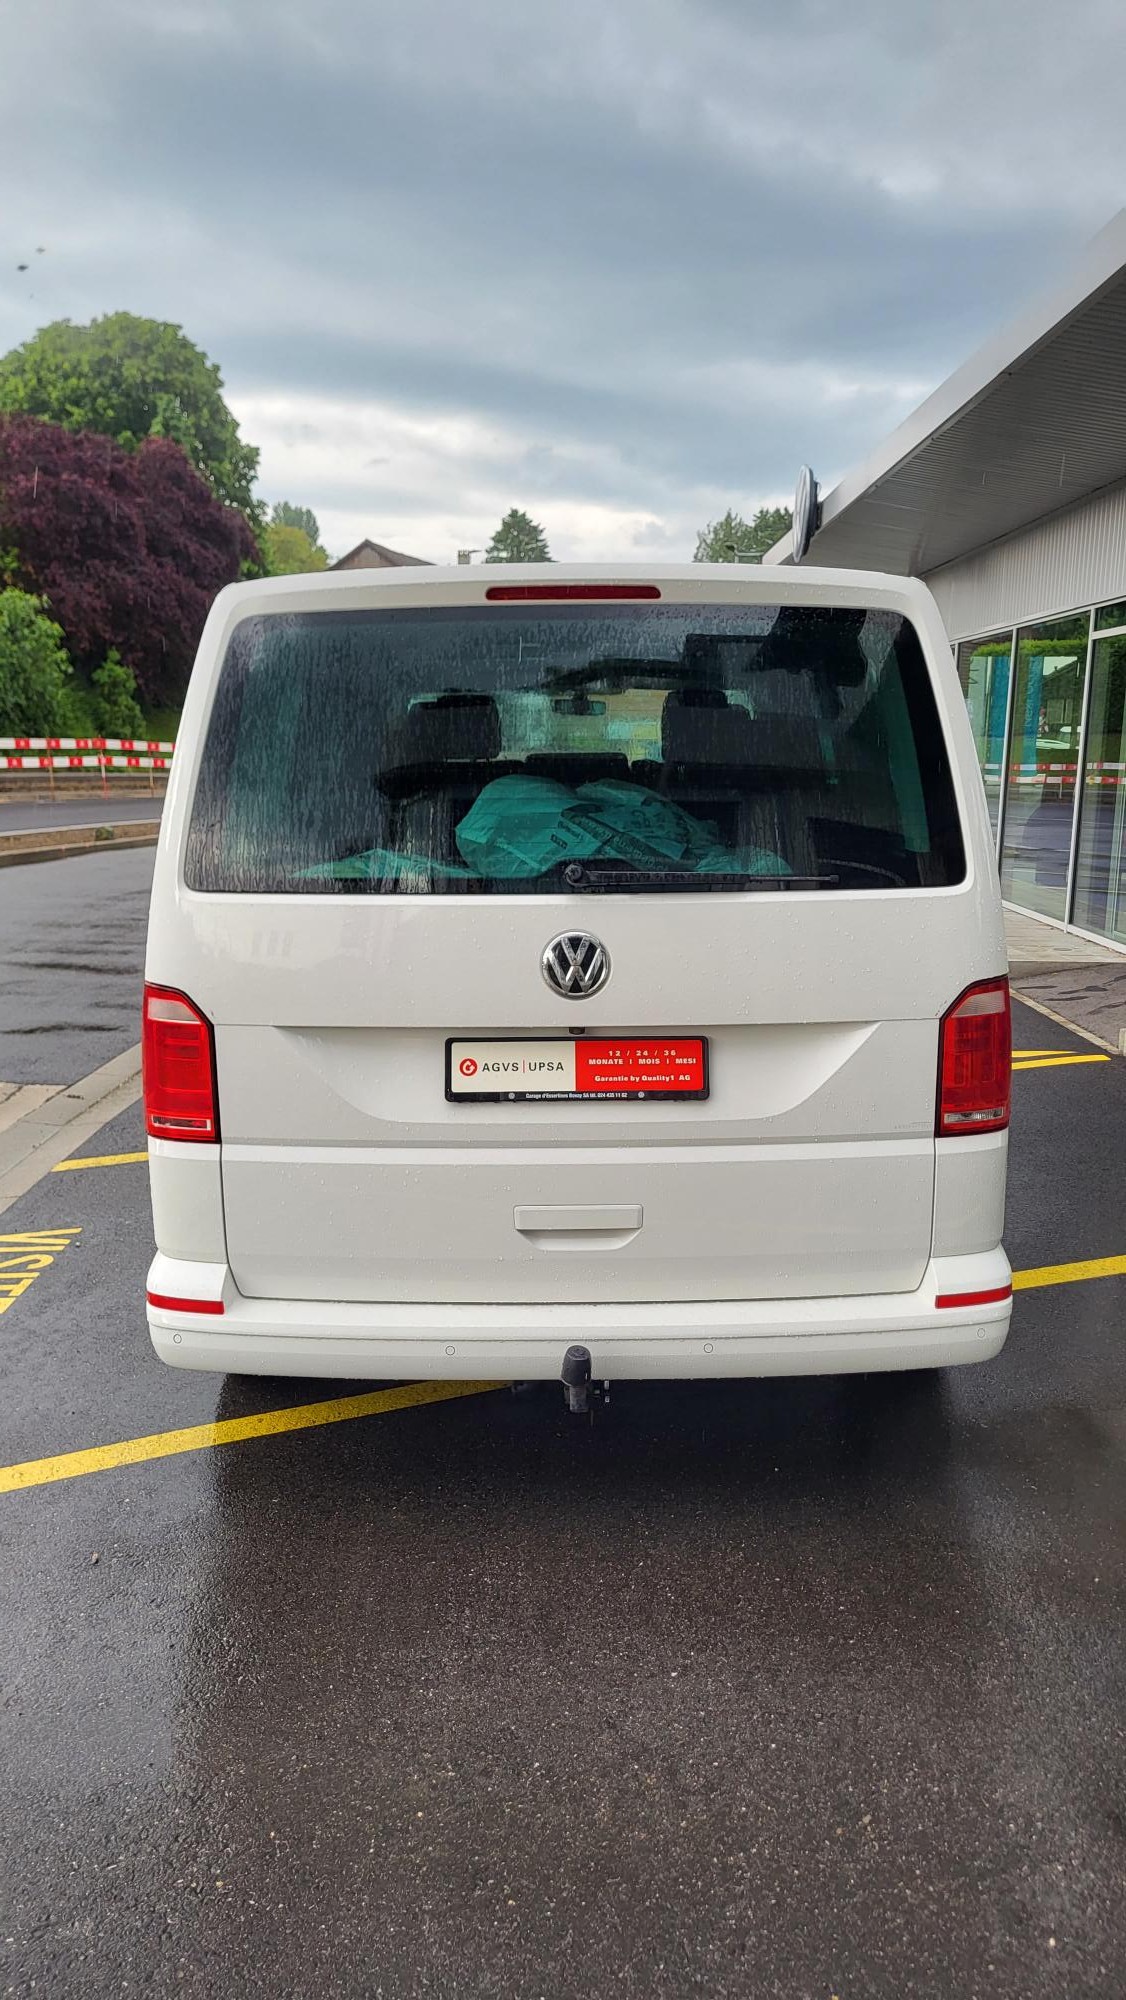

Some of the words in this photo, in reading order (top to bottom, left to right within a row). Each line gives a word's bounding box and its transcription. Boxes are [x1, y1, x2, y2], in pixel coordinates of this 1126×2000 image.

[481, 1062, 520, 1072] AGVS
[528, 1061, 565, 1072] UPSA
[630, 1075, 640, 1083] by
[641, 1074, 675, 1083] Quality1
[525, 1092, 542, 1100] Garage
